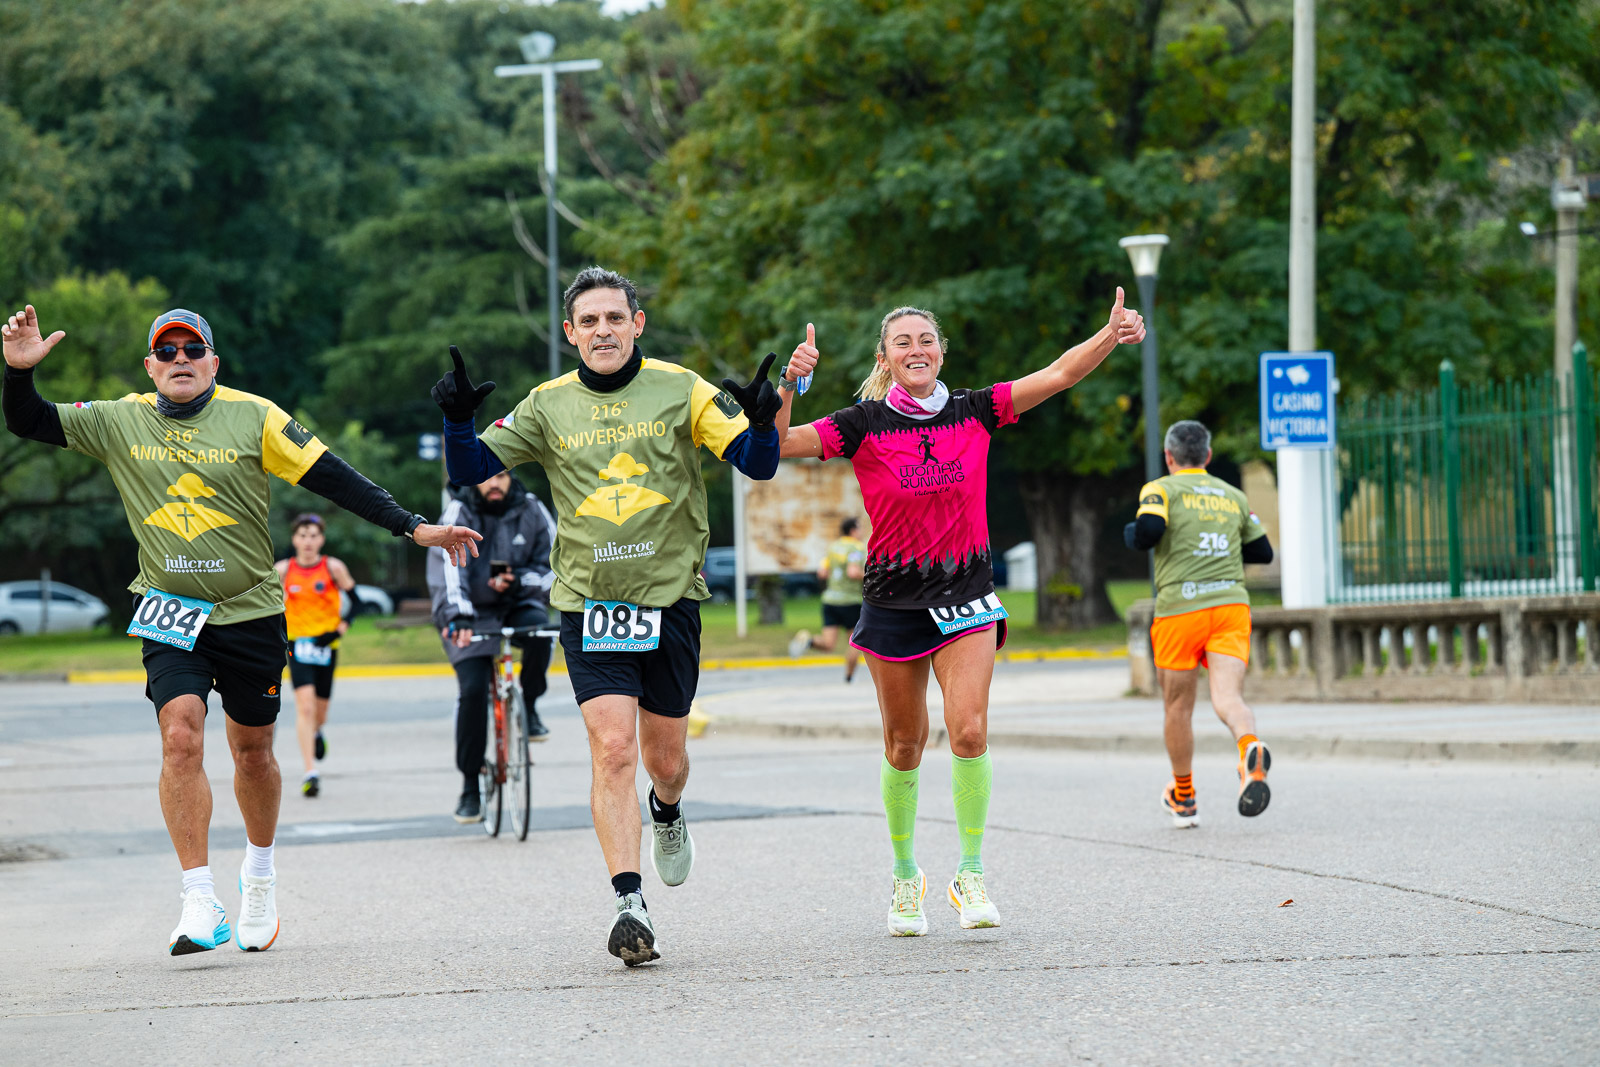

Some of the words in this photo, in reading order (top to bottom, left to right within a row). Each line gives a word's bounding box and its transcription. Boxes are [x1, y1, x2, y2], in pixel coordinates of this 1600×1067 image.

[591, 401, 628, 420] 216°
[1273, 392, 1322, 412] CASINO
[164, 428, 199, 443] 216°
[1267, 417, 1326, 436] VICTORIA
[559, 421, 666, 452] ANIVERSARIO
[130, 444, 239, 464] ANIVERSARIO
[900, 459, 963, 478] WOMAN
[901, 472, 965, 489] RUNNING
[1182, 493, 1240, 514] VICTORIA
[1198, 532, 1229, 550] 216
[593, 541, 654, 563] julicroc
[638, 550, 656, 558] snacks
[165, 554, 225, 572] julicroc
[139, 594, 203, 638] 084
[588, 603, 653, 641] 085
[945, 618, 979, 633] DIAMANTE
[980, 612, 1004, 623] CORRE
[131, 626, 166, 641] DIAMANTE
[166, 634, 192, 648] CORRE
[586, 642, 627, 650] DIAMANTE
[628, 642, 655, 650] CORRE
